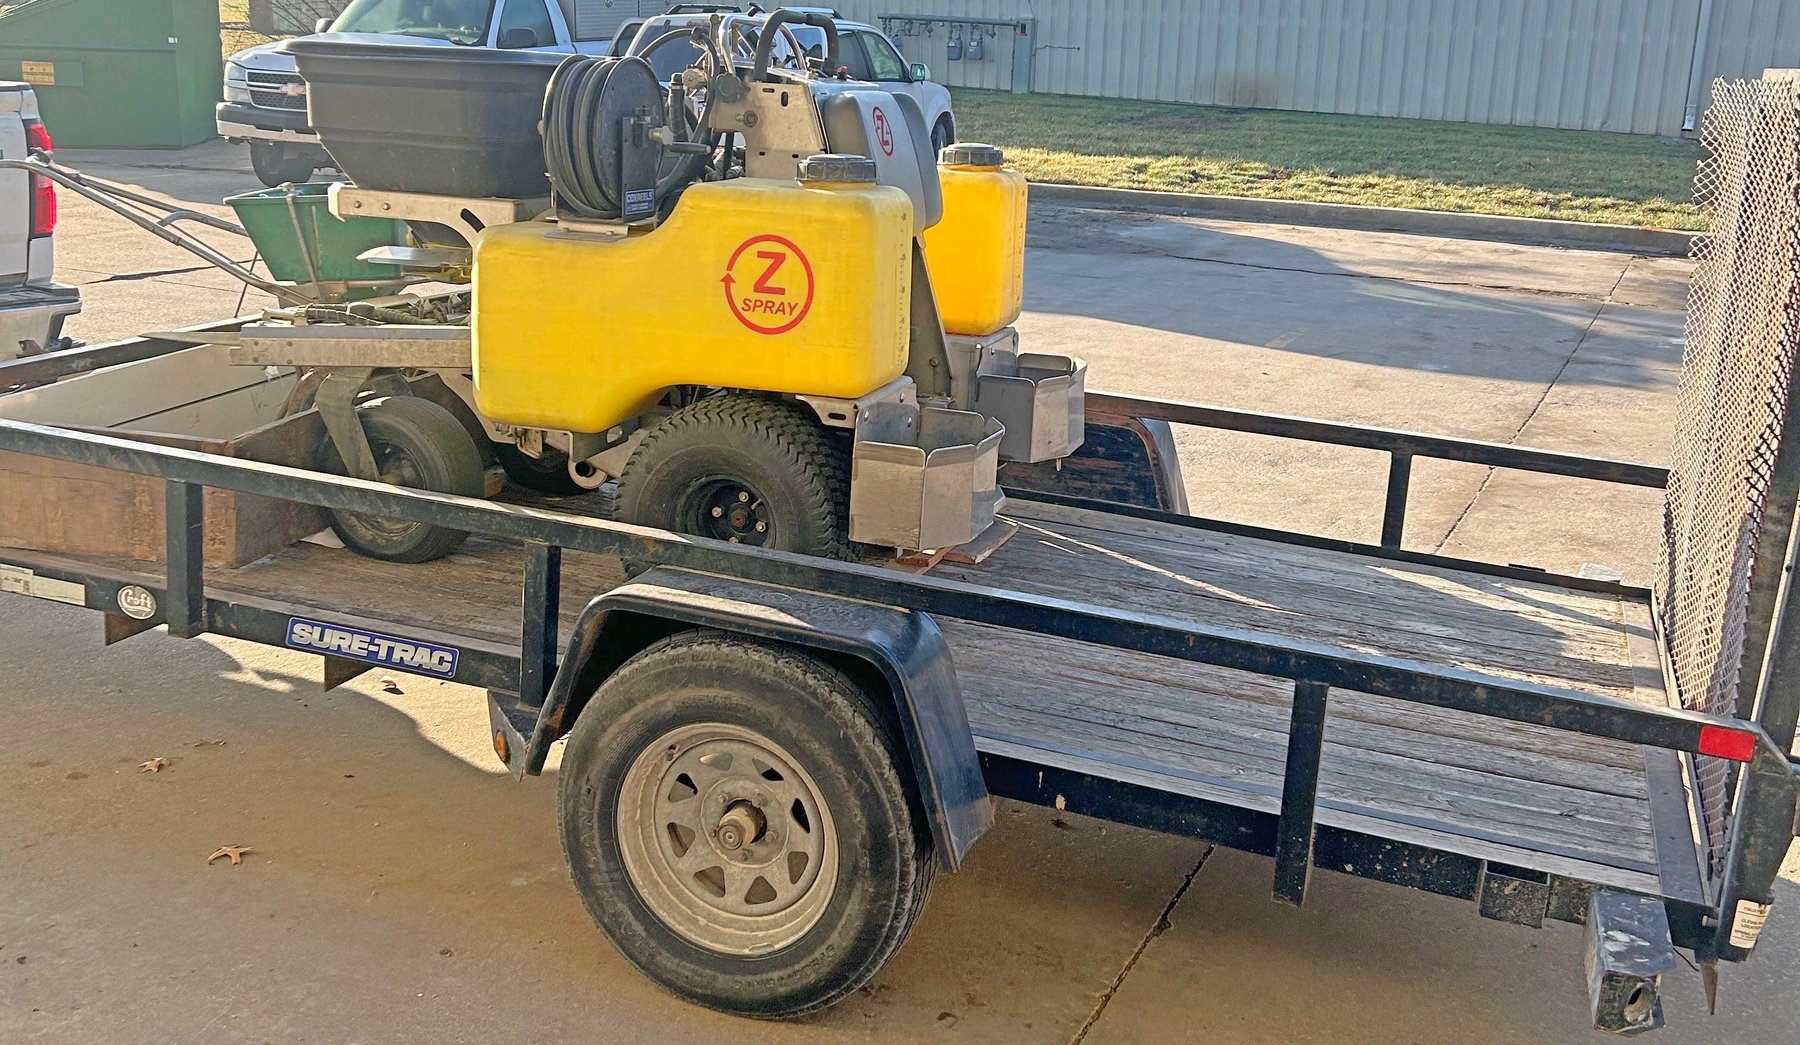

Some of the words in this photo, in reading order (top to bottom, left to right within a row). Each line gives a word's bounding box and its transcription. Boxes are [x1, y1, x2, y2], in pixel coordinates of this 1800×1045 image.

[753, 250, 787, 295] Z
[741, 298, 799, 316] SPRAY
[121, 589, 152, 611] Croft
[291, 623, 453, 672] SURE-TRAC
